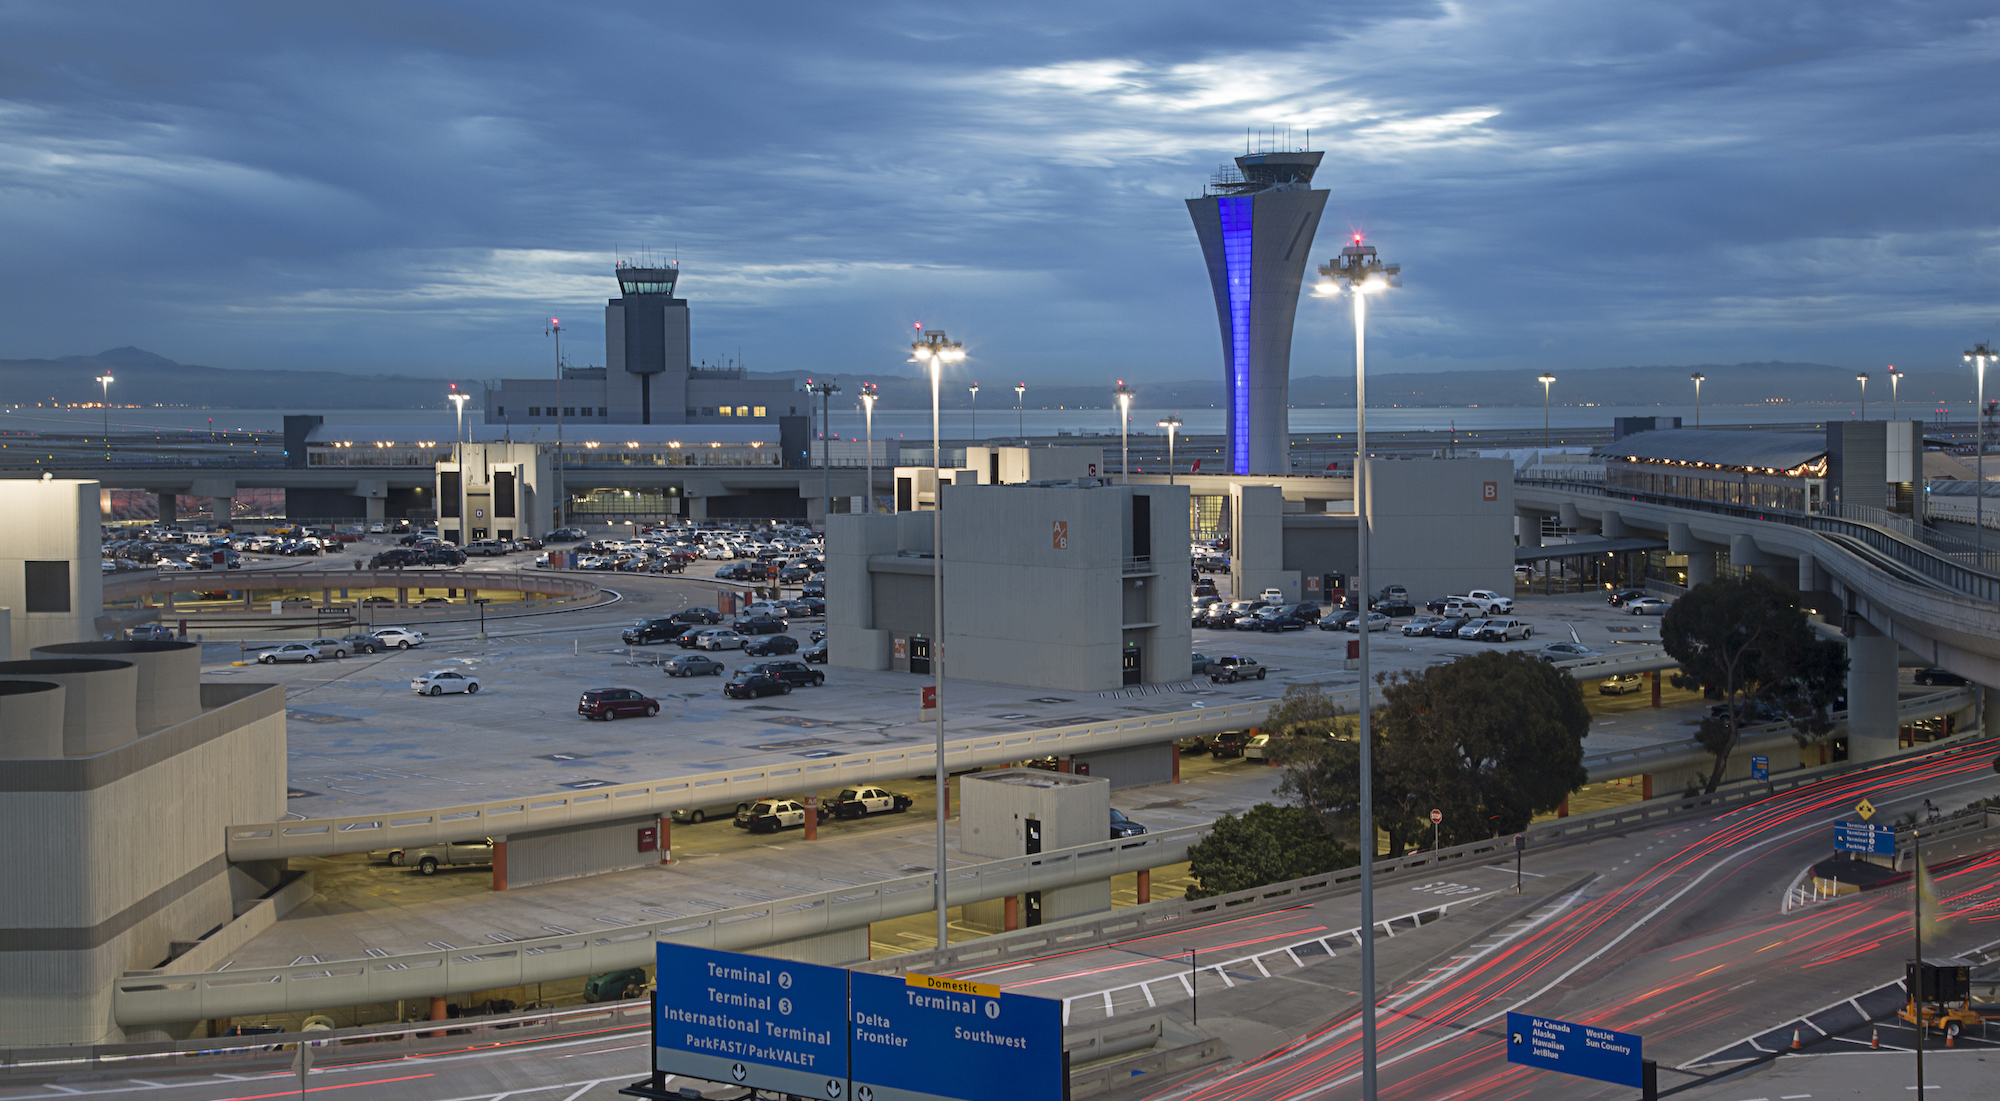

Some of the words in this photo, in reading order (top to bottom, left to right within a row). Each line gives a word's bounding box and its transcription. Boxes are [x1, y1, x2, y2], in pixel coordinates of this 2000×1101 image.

[1485, 485, 1496, 497] B
[1846, 843, 1866, 851] Parking
[707, 962, 771, 985] Terminal
[928, 977, 978, 994] Domestic
[707, 987, 771, 1010] Terminal
[906, 990, 976, 1015] Terminal
[664, 1005, 759, 1034] International
[765, 1021, 831, 1046] Terminal
[856, 1011, 890, 1028] Delta
[1532, 1019, 1543, 1028] Air
[1543, 1021, 1571, 1033] Canada
[856, 1028, 908, 1047] Frontier
[954, 1026, 1027, 1049] Southwest
[1532, 1028, 1556, 1039] Alaska
[1585, 1028, 1614, 1041] WestJet
[686, 1033, 815, 1067] ParkFAST/ParkVALET
[1532, 1037, 1565, 1051] Hawaiian
[1585, 1039, 1600, 1048] Sun
[1600, 1041, 1631, 1056] Country
[1532, 1047, 1559, 1059] JetBlue
